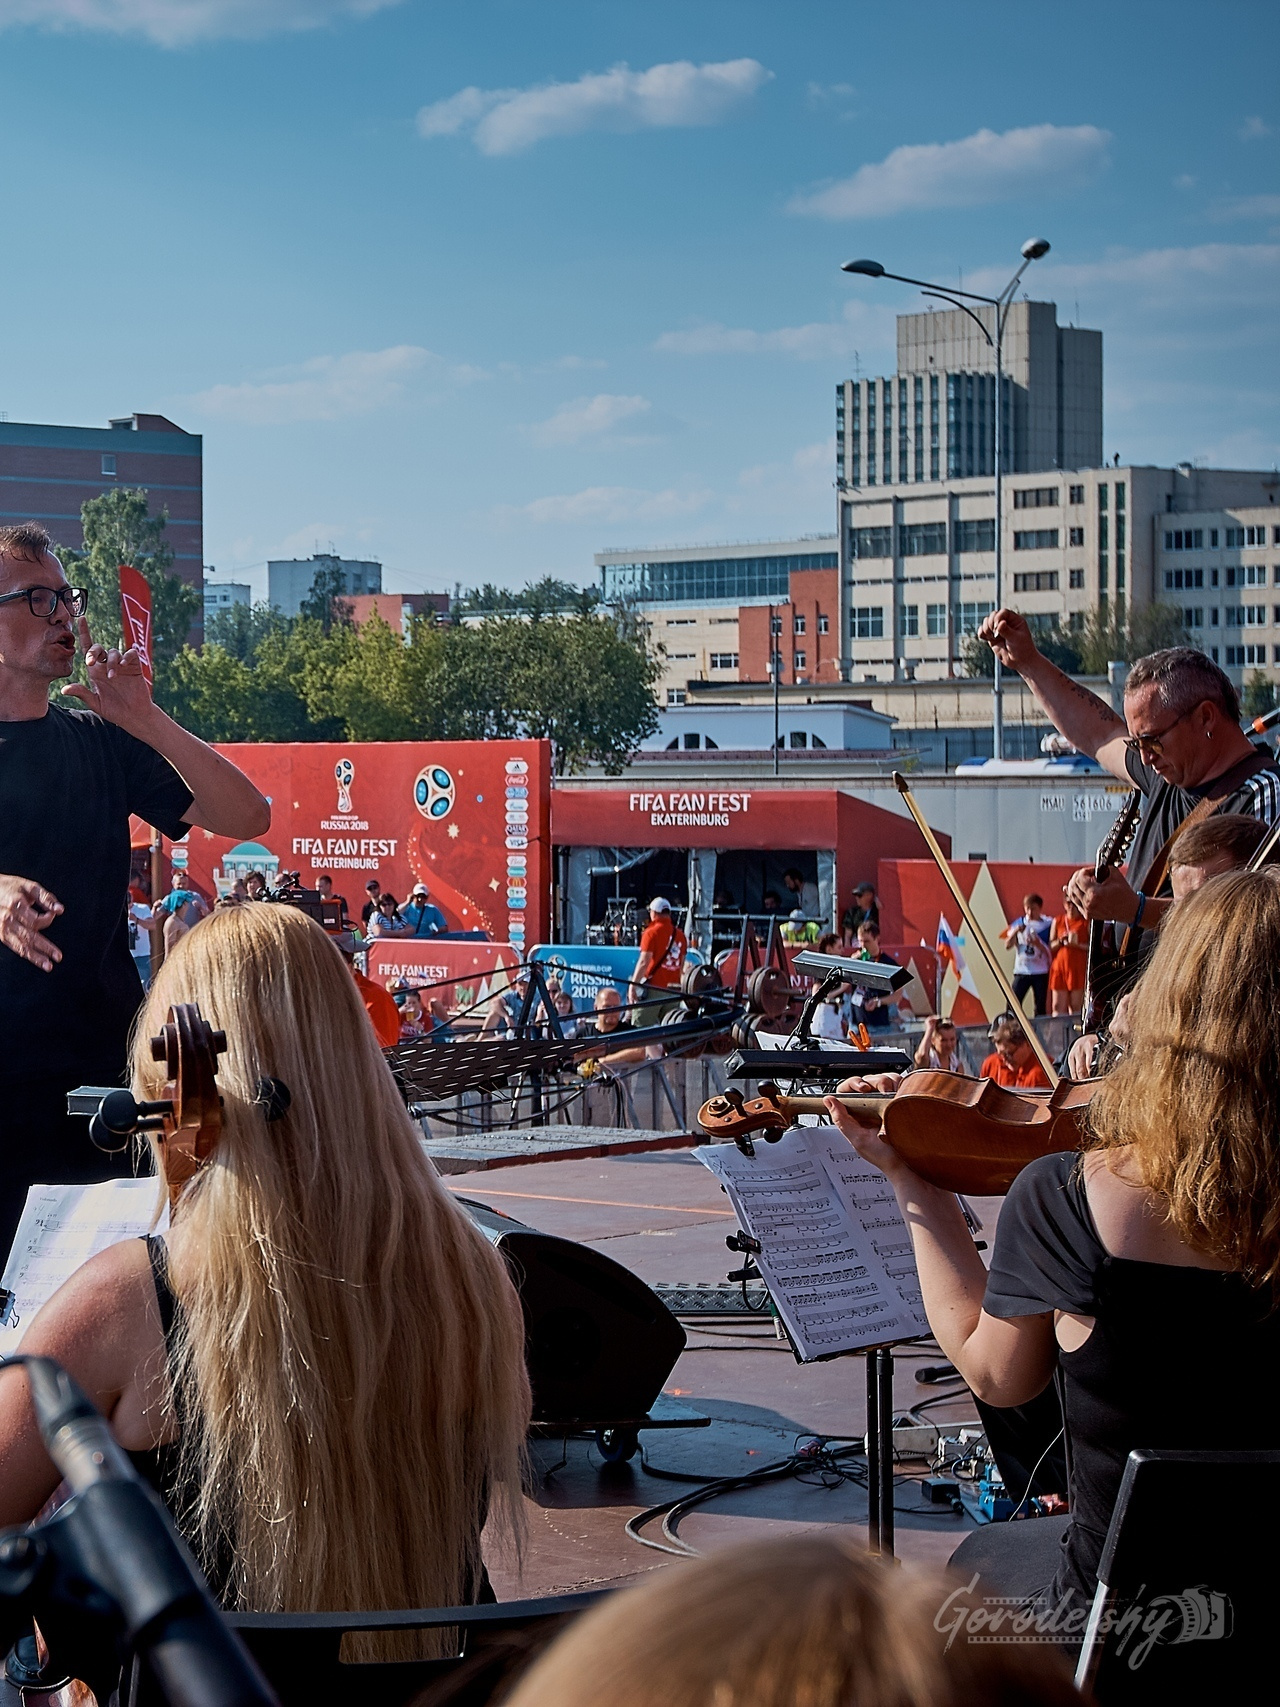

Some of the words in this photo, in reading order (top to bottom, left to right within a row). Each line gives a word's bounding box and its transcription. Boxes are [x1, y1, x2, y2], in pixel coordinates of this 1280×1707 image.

[629, 793, 666, 812] FIFA
[669, 793, 705, 812] FAN
[708, 793, 752, 812] FEST
[320, 820, 350, 830] RUSSIA
[350, 821, 369, 831] 2018
[651, 813, 730, 826] EKATERINBURG
[292, 838, 324, 855] FIFA
[327, 838, 358, 856] FAN
[360, 839, 398, 857] FEST
[311, 857, 379, 870] EKATERINBURG
[378, 963, 400, 976] FIFA
[401, 964, 423, 977] FAN
[423, 965, 448, 978] FEST
[571, 985, 599, 999] 2018
